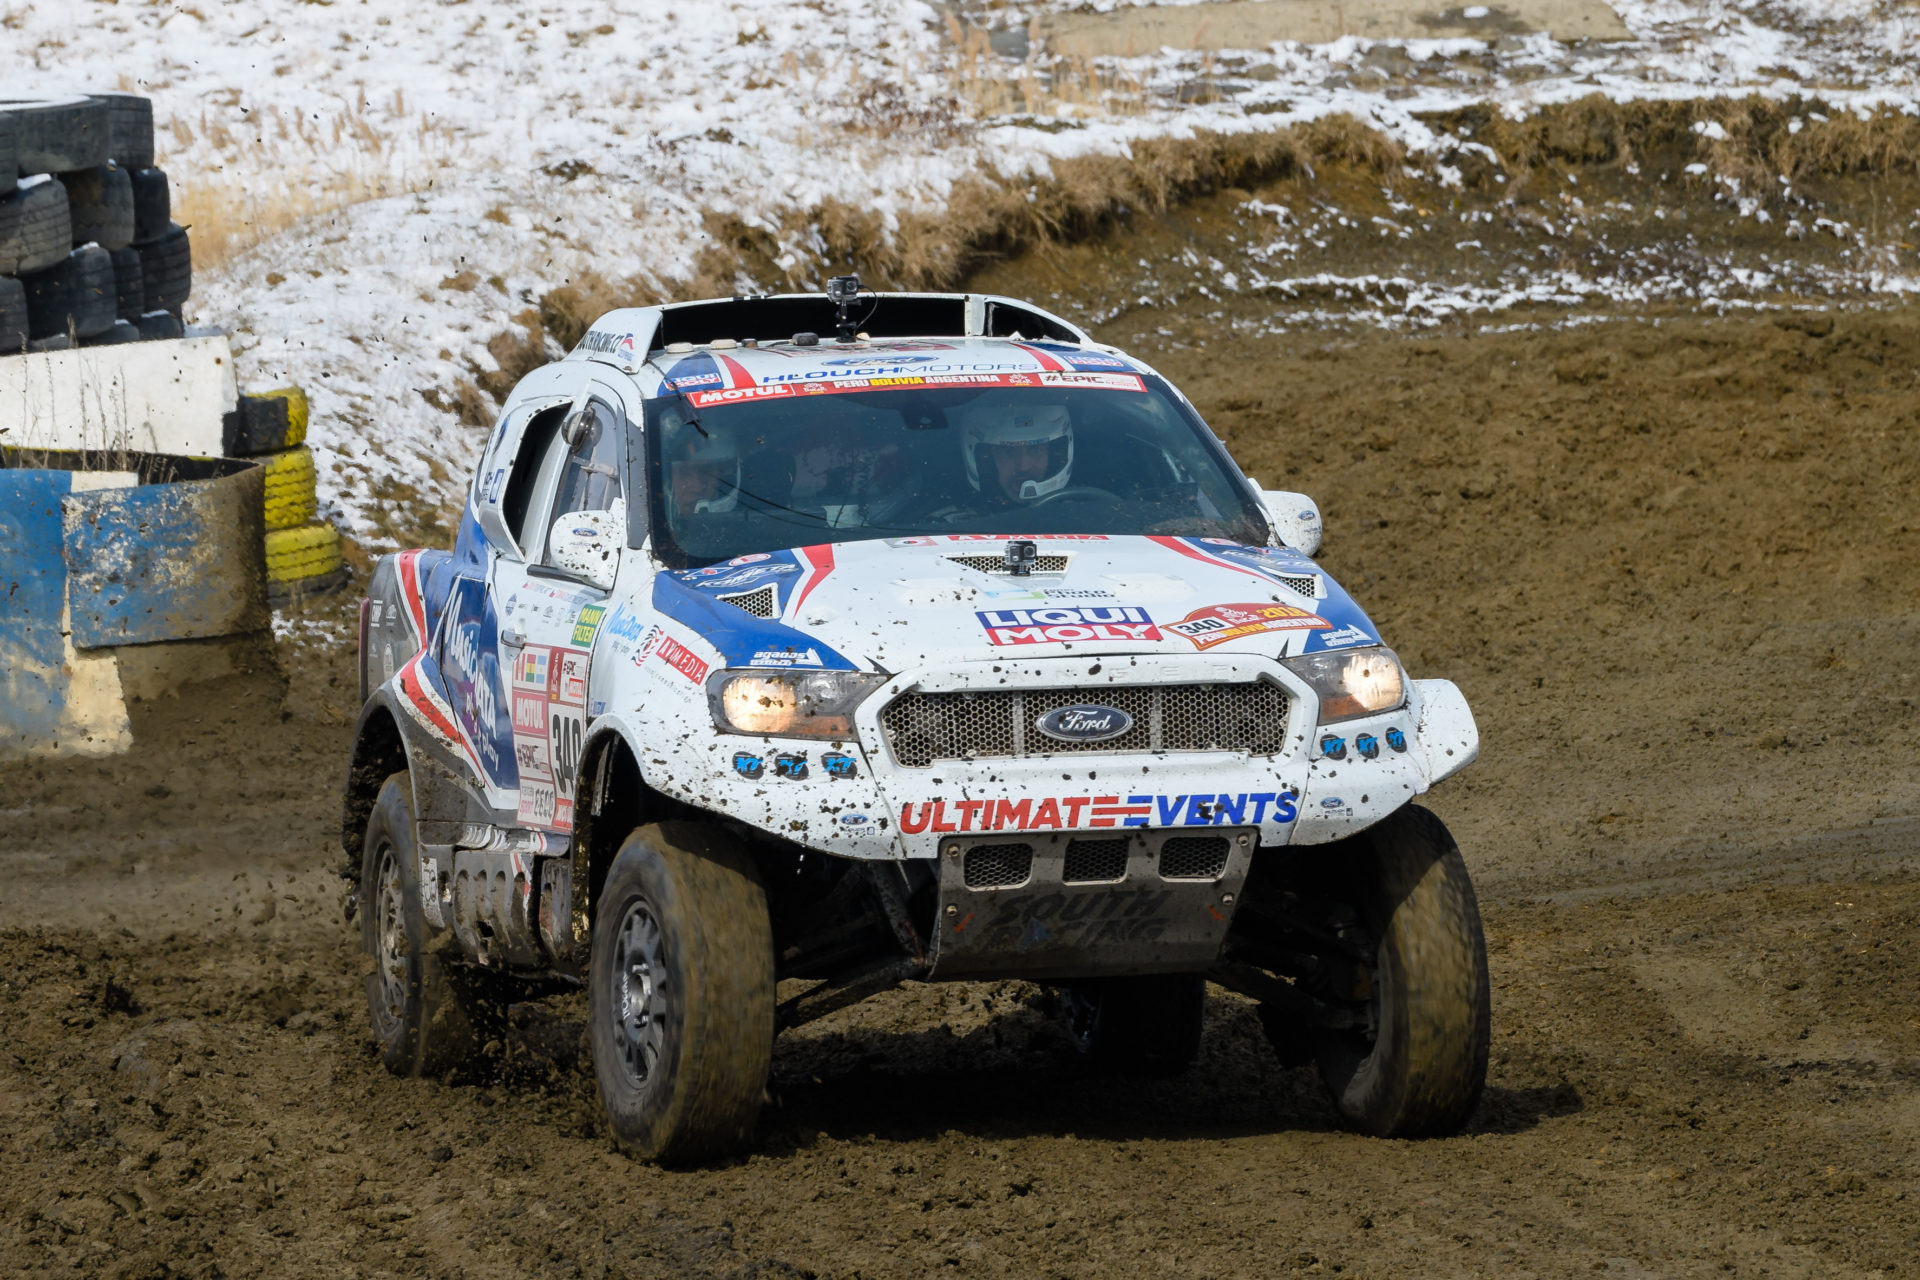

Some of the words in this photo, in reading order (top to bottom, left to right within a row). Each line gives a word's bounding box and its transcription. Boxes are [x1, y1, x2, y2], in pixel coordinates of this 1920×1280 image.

[833, 380, 870, 389] PERU
[870, 376, 923, 386] BOLIVIA
[923, 374, 1000, 384] ARGENTINA
[700, 386, 788, 403] MOTUL
[578, 607, 603, 625] MANN
[984, 607, 1144, 627] LIQUI
[572, 625, 595, 643] FILTER
[994, 624, 1153, 645] MOLY
[1176, 619, 1226, 637] 340
[1197, 631, 1227, 645] PERU
[1224, 624, 1268, 638] BOLIVIA
[1261, 617, 1326, 630] ARGENTINA
[753, 650, 807, 660] agados
[516, 697, 544, 729] MOTUL
[1059, 708, 1112, 732] Ford
[985, 889, 1174, 928] SOUTH
